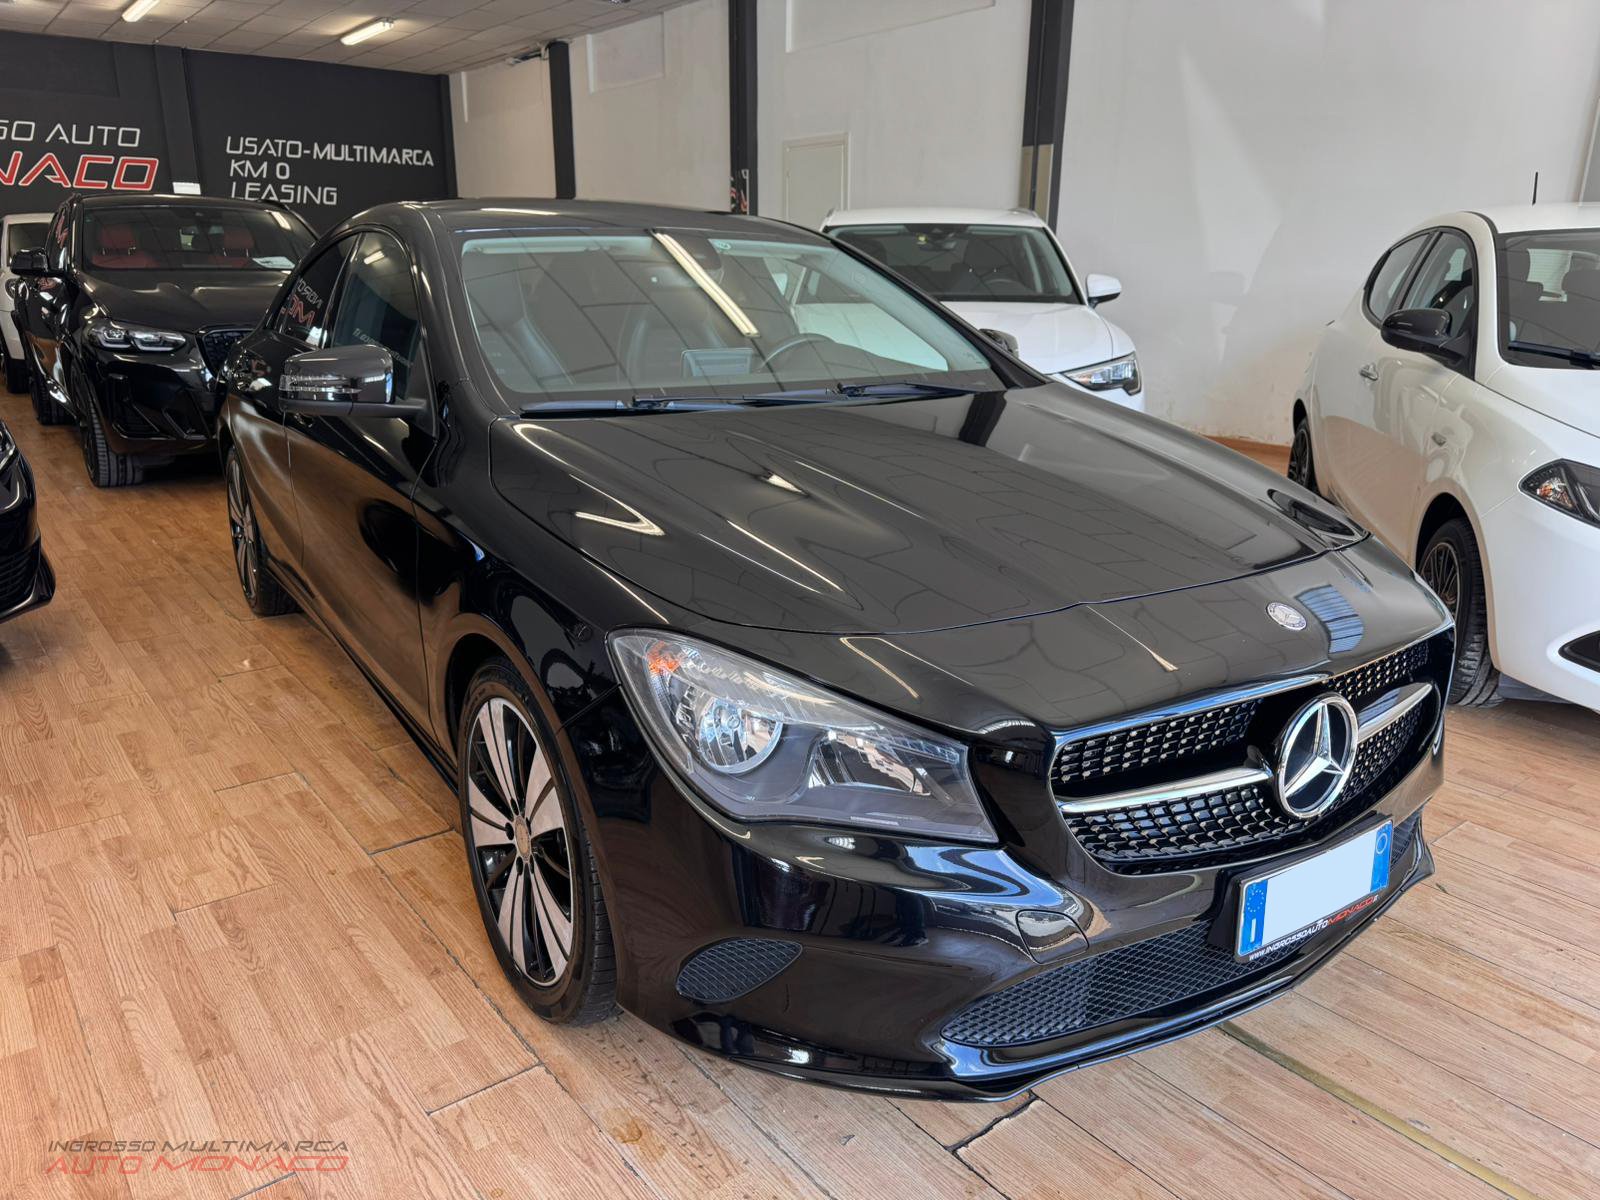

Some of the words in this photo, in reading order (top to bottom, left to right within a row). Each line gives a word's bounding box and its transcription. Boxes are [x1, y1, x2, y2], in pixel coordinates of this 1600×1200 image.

[45, 122, 141, 148] AUTO
[225, 135, 434, 167] USATO-MULTIMARCA
[229, 159, 268, 179] KM
[231, 181, 338, 206] LEASING
